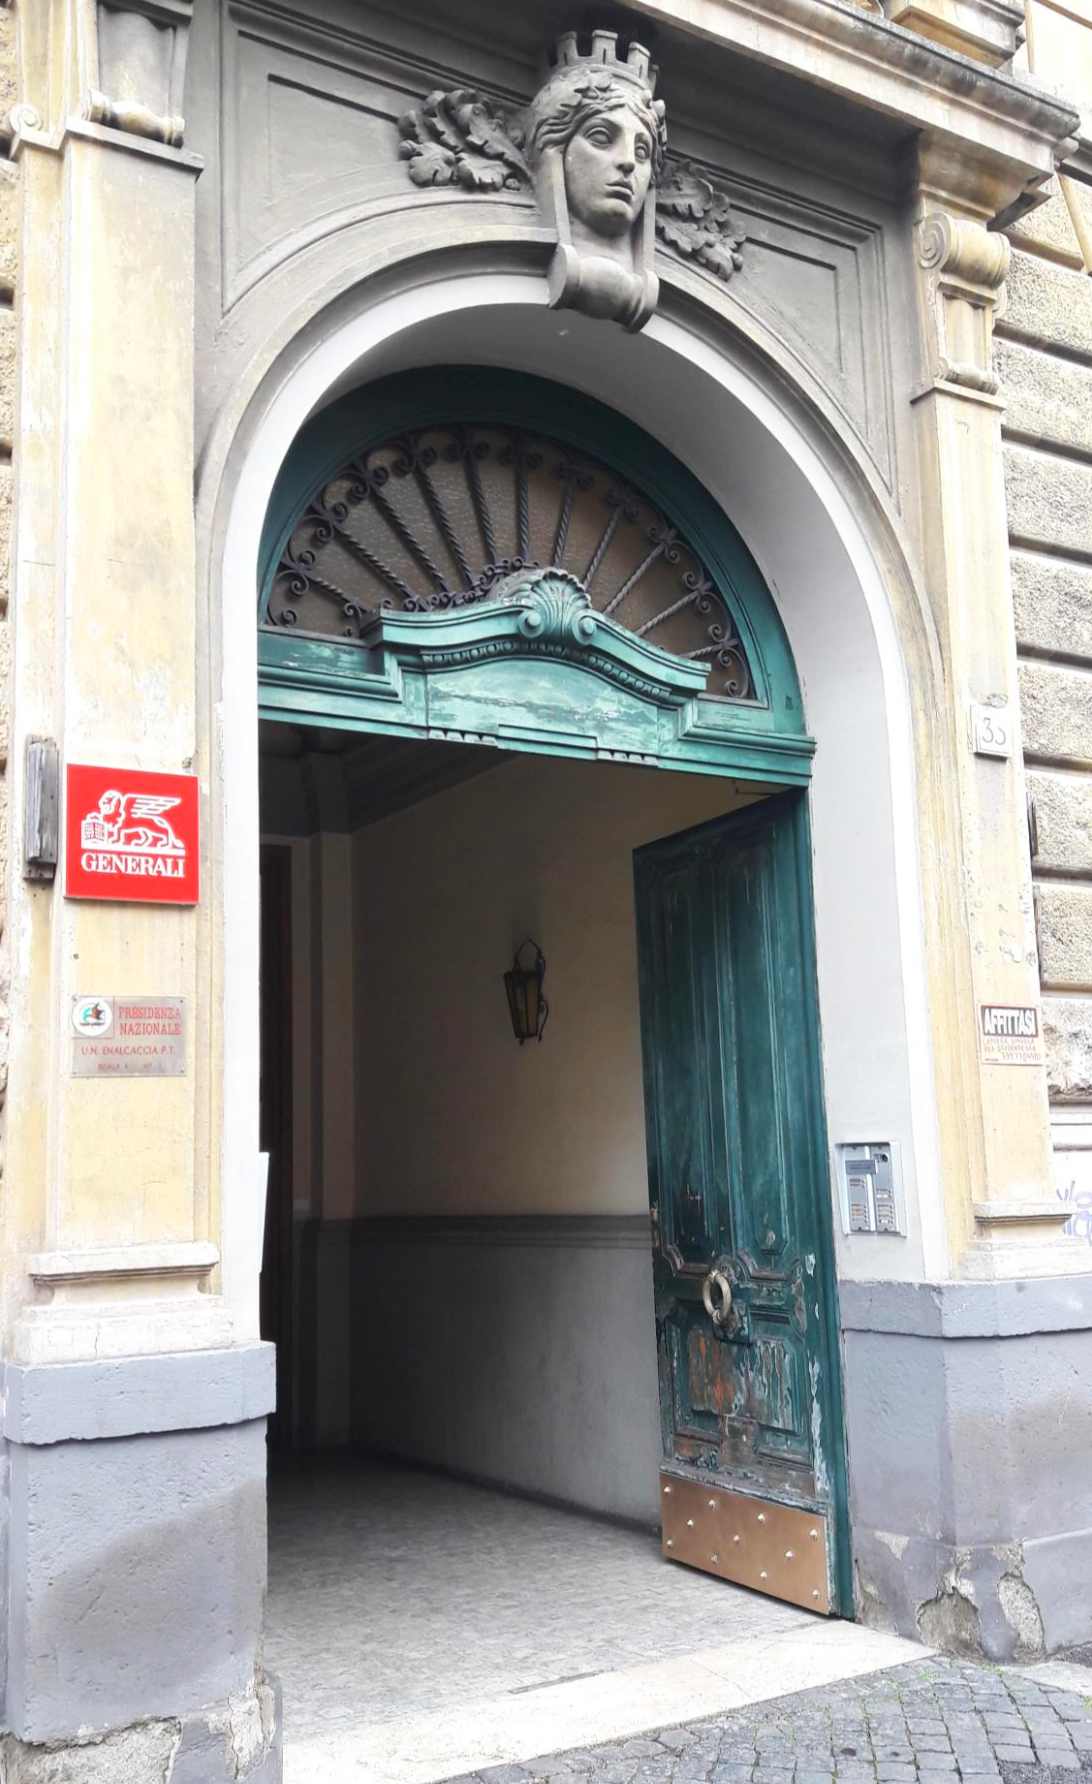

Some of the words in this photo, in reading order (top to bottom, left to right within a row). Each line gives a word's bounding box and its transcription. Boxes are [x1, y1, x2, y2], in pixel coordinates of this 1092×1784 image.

[81, 852, 185, 878] GENERALI
[118, 1006, 182, 1020] PRESIDENZA
[119, 1022, 182, 1036] NAZIONALE
[984, 1008, 1037, 1036] AFFITTASI
[102, 1045, 159, 1056] ENALCACCIA
